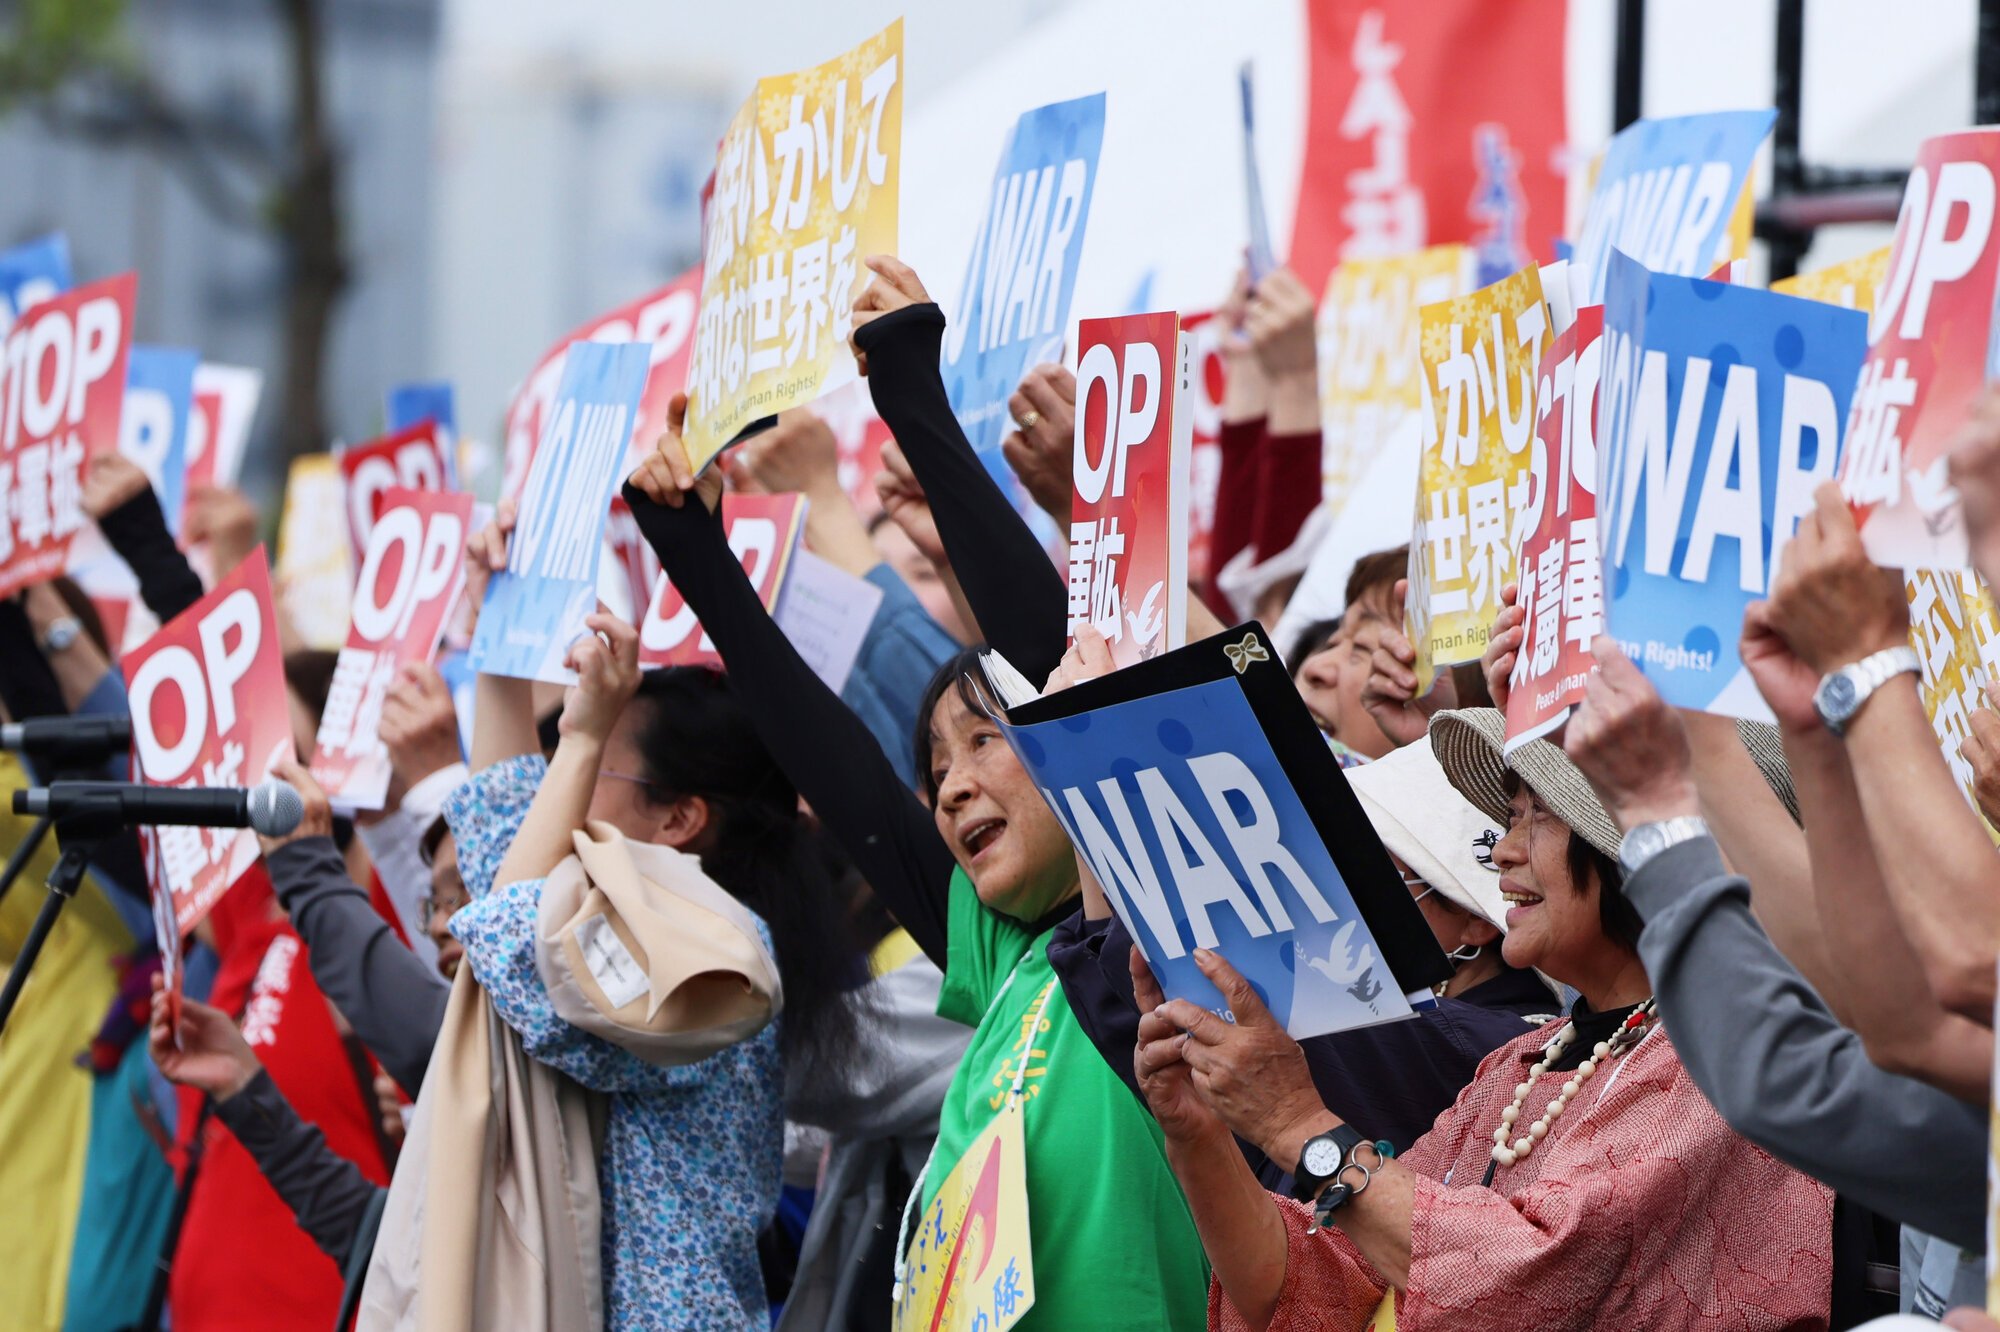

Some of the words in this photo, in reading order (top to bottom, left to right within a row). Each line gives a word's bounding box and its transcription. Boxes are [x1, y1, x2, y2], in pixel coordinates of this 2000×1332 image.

[978, 157, 1086, 355] WAR
[775, 371, 817, 400] Rights!
[1072, 341, 1162, 505] OP
[352, 504, 462, 642] OP
[127, 587, 262, 783] OP
[1534, 688, 1555, 713] Peace
[1643, 638, 1714, 673] Rights!
[1041, 751, 1339, 962] WAR
